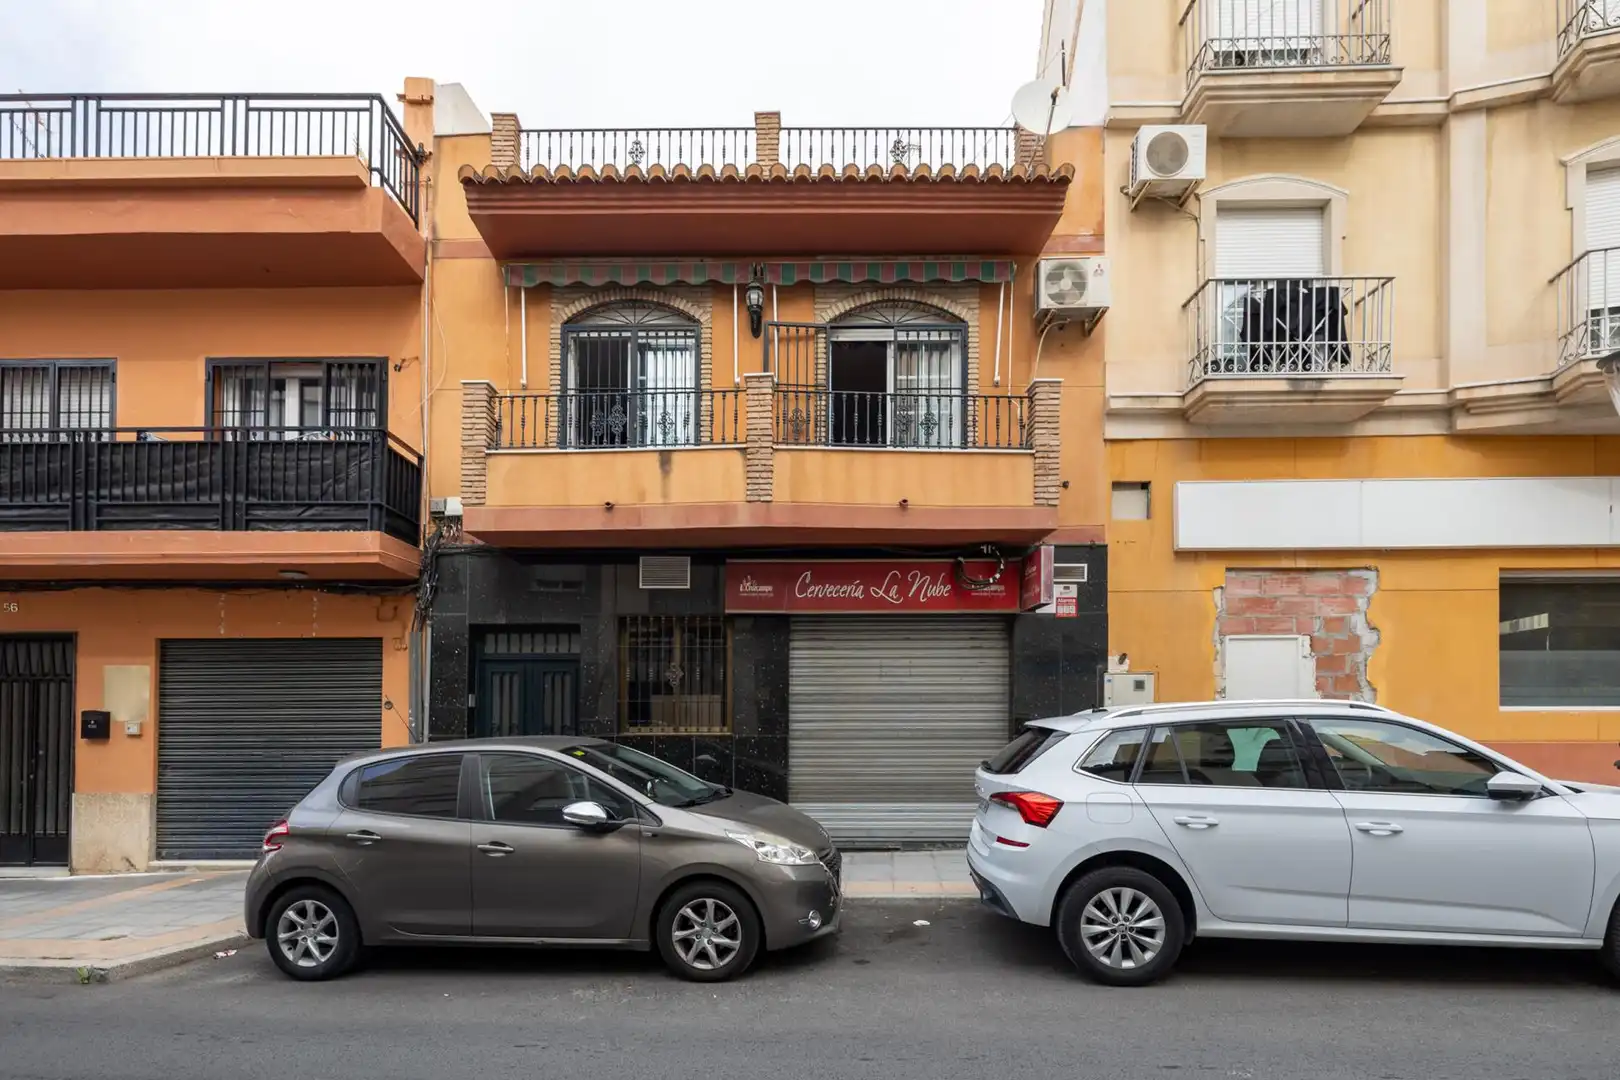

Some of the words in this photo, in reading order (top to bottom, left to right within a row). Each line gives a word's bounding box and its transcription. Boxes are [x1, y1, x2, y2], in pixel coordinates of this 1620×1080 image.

[795, 570, 865, 599] Cervecería
[870, 570, 904, 604] La
[907, 570, 952, 602] Nube
[3, 602, 19, 613] 56
